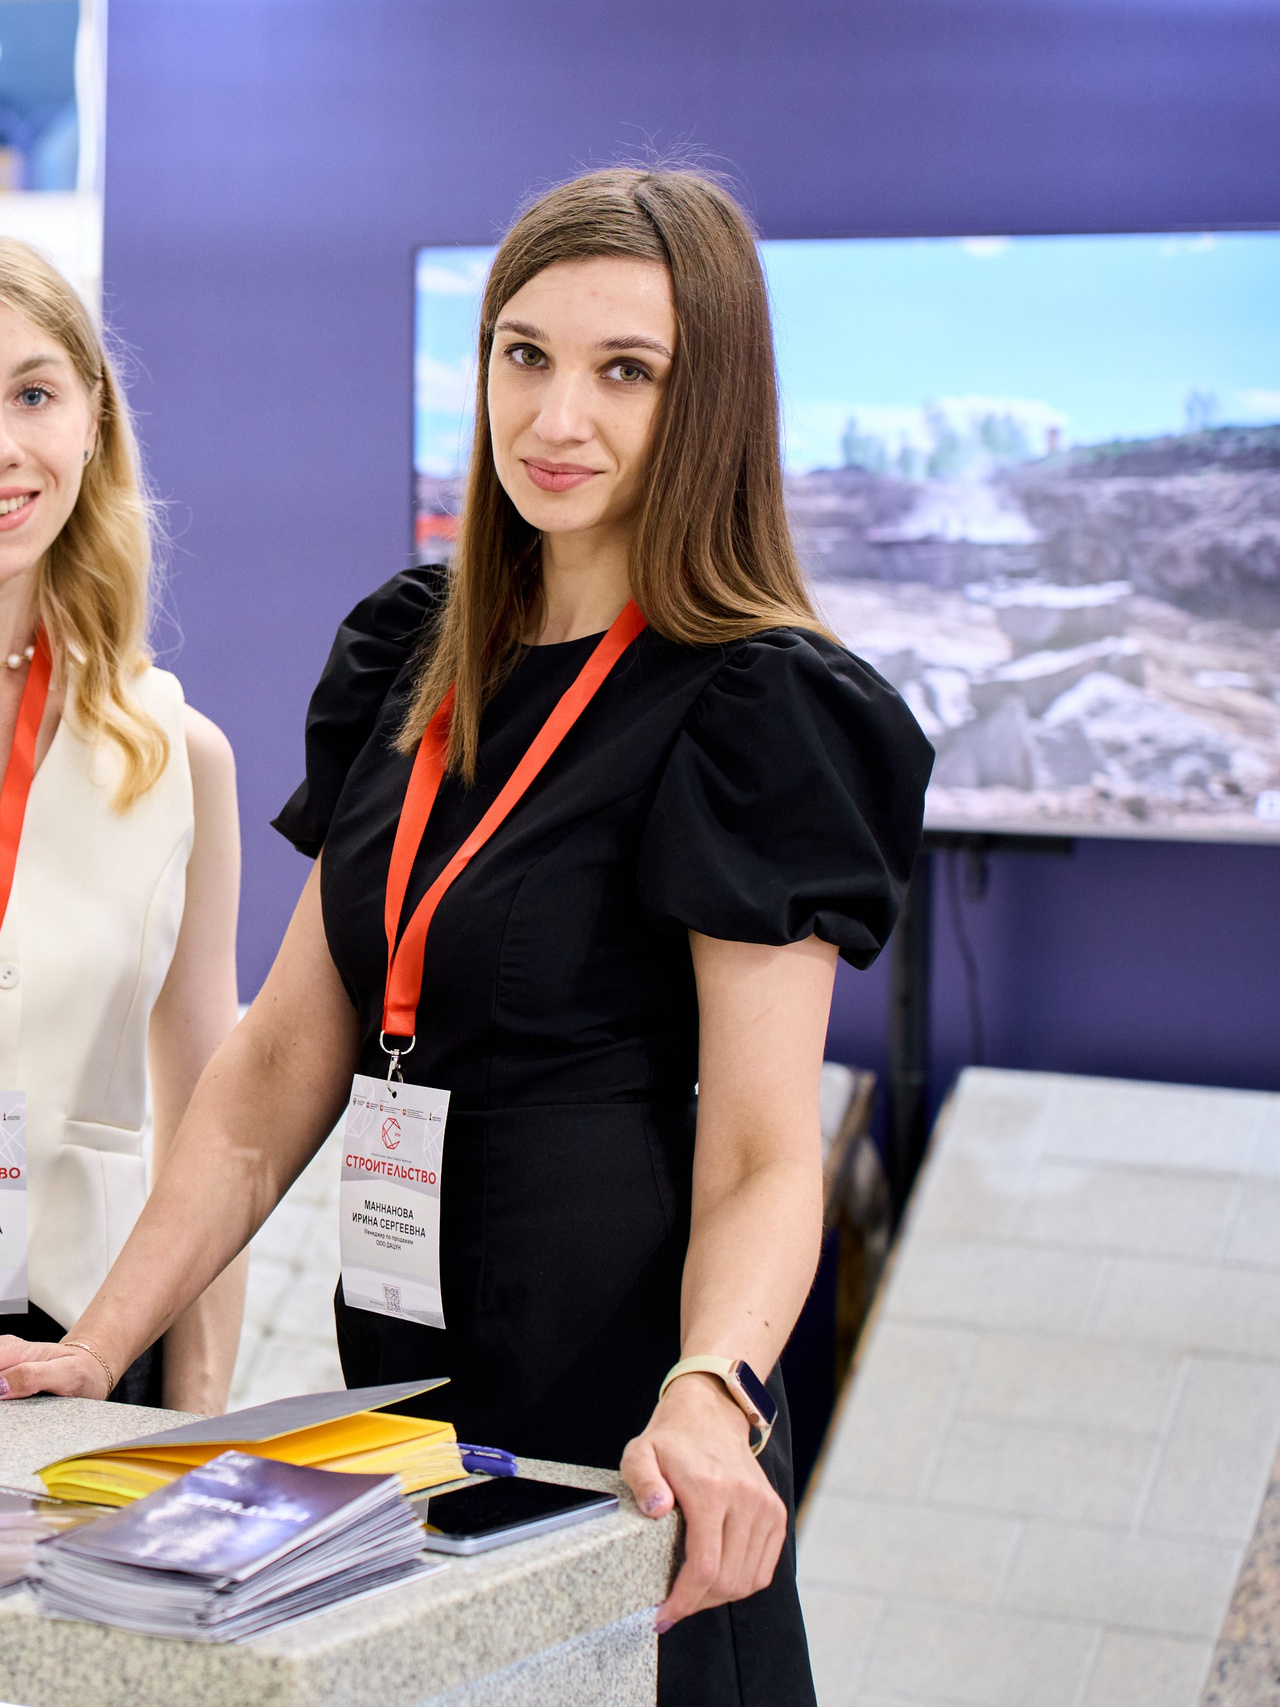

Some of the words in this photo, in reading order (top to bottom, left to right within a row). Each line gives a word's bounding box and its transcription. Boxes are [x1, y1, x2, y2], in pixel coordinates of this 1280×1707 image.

[345, 1154, 436, 1185] СТРОИТЕЛЬСТВО
[364, 1199, 415, 1220] МАННАНОВА
[351, 1212, 379, 1228] ИРИНА
[379, 1218, 427, 1238] СЕРГЕЕВНА
